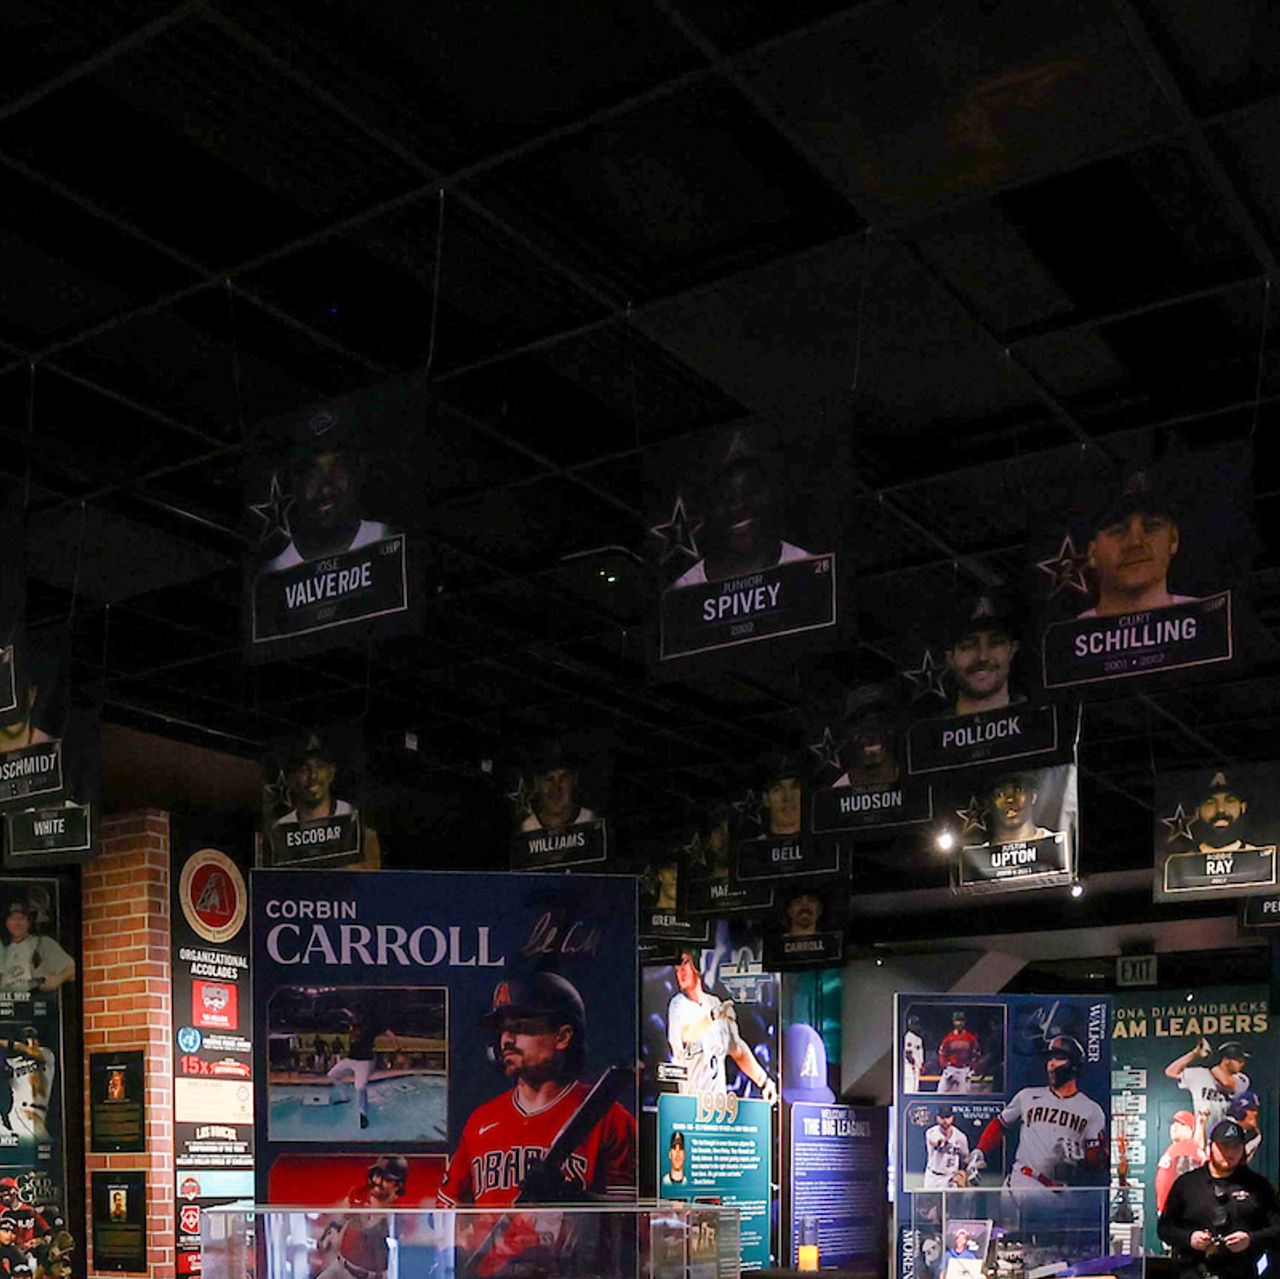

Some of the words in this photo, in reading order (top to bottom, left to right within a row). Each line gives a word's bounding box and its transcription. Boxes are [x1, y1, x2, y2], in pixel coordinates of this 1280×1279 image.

[285, 562, 372, 609] VALVERDE
[722, 575, 764, 594] JUNIOR
[702, 582, 782, 622] SPIVEY
[1073, 617, 1197, 657] SCHILLING
[942, 716, 1022, 748] POLLOCK
[840, 790, 903, 813] HUDSON
[33, 818, 65, 836] WHITE
[286, 826, 342, 847] ESCOBAR
[528, 832, 586, 853] WILLIAMS
[771, 845, 803, 862] BELL
[991, 848, 1037, 867] UPTON
[1206, 859, 1234, 875] RAY
[266, 900, 357, 919] CORBIN
[267, 924, 505, 967] CARROLL
[783, 940, 825, 953] CARROLL
[179, 948, 249, 969] ORGANIZATIONAL
[190, 963, 238, 980] ACCOLADES
[1122, 961, 1152, 982] EXIT
[1151, 1001, 1268, 1017] DIAMONDBACKS
[1088, 1004, 1101, 1062] WALKER
[1154, 1013, 1269, 1037] LEADERS
[181, 1055, 210, 1075] 15x
[695, 1088, 738, 1123] 1999
[803, 1117, 821, 1136] THE
[1026, 1107, 1088, 1133] ARIZONA
